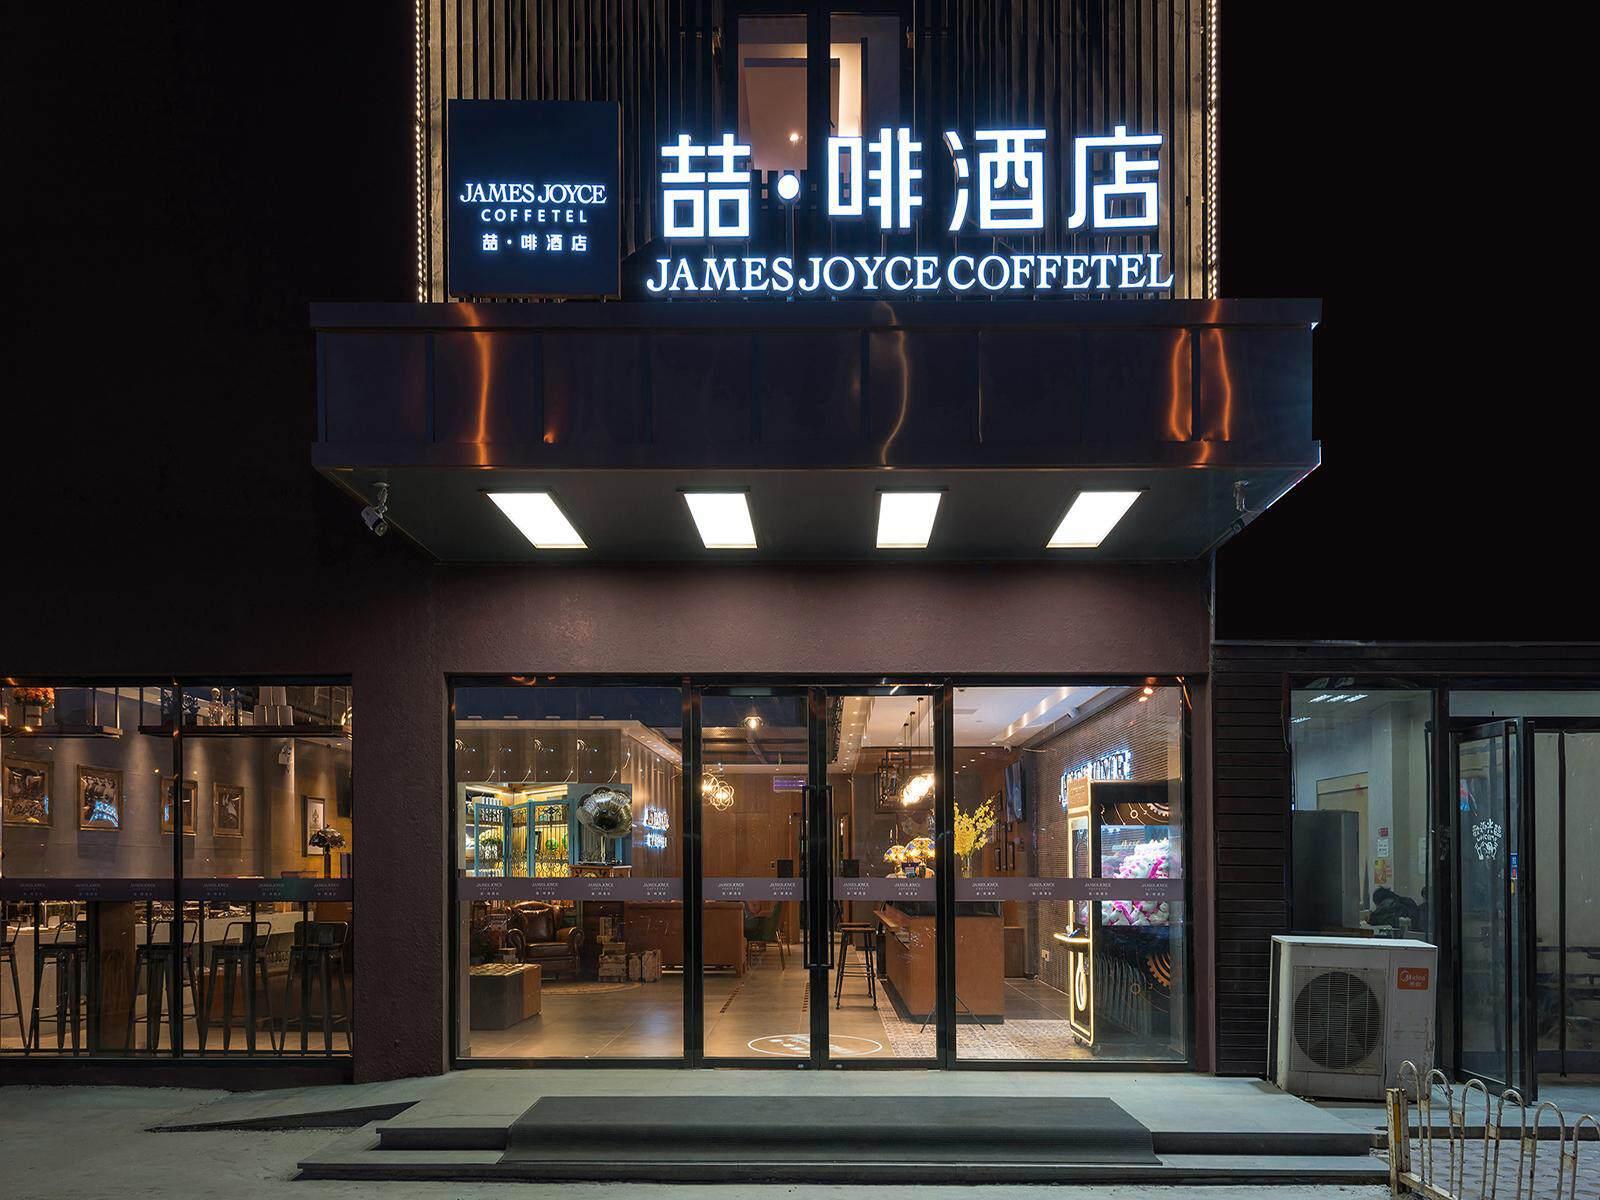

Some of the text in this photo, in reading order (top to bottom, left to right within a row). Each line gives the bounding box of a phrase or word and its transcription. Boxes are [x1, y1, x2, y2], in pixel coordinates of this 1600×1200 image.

[459, 182, 608, 205] JAMES JOYCE
[480, 208, 589, 224] COFFETEL
[646, 252, 1174, 293] JAMES JOYCE COFFETEL
